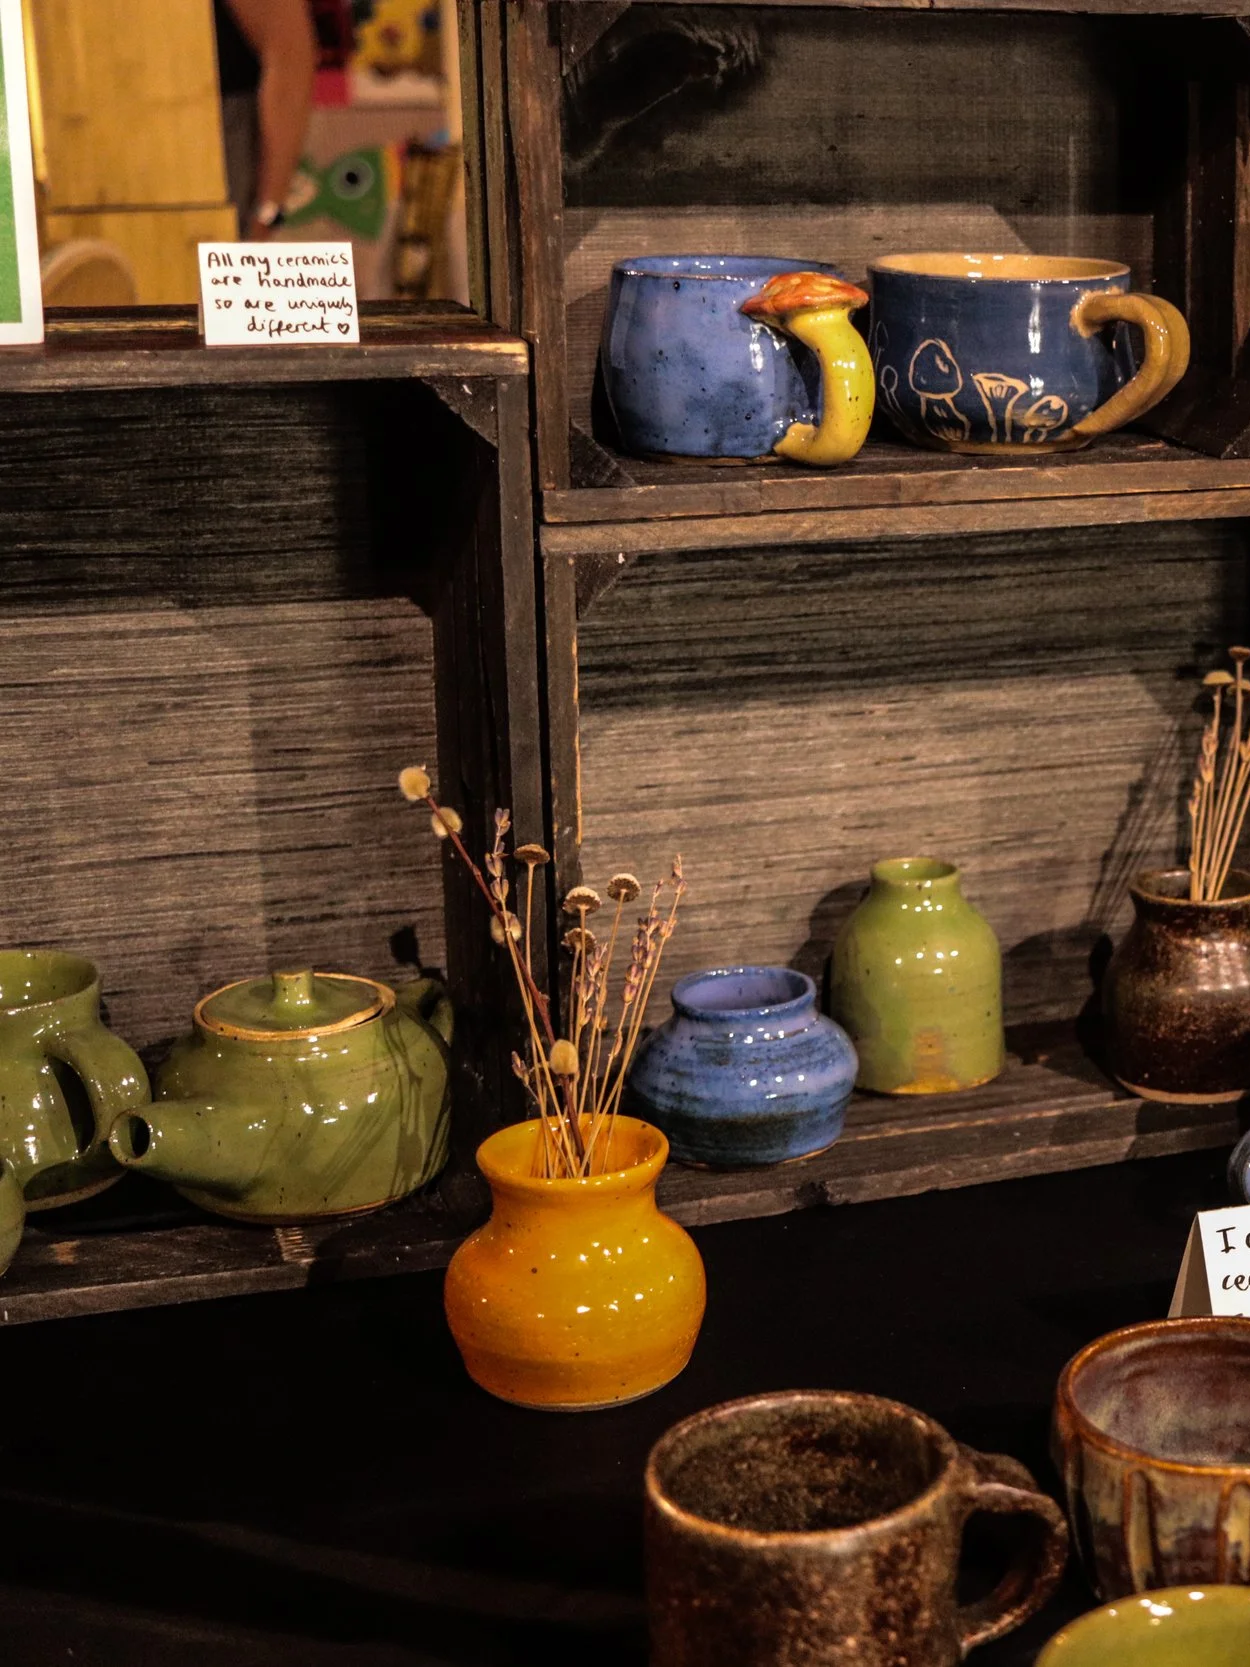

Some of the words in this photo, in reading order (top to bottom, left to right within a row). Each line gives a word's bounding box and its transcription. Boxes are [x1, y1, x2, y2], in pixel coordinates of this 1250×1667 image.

[208, 252, 233, 268] All
[240, 255, 270, 276] my
[277, 253, 349, 267] ceramics
[211, 276, 242, 286] are
[258, 272, 352, 288] handmade
[215, 299, 232, 309] so
[244, 300, 276, 312] are
[247, 316, 330, 338] different
[1216, 1227, 1236, 1253] I
